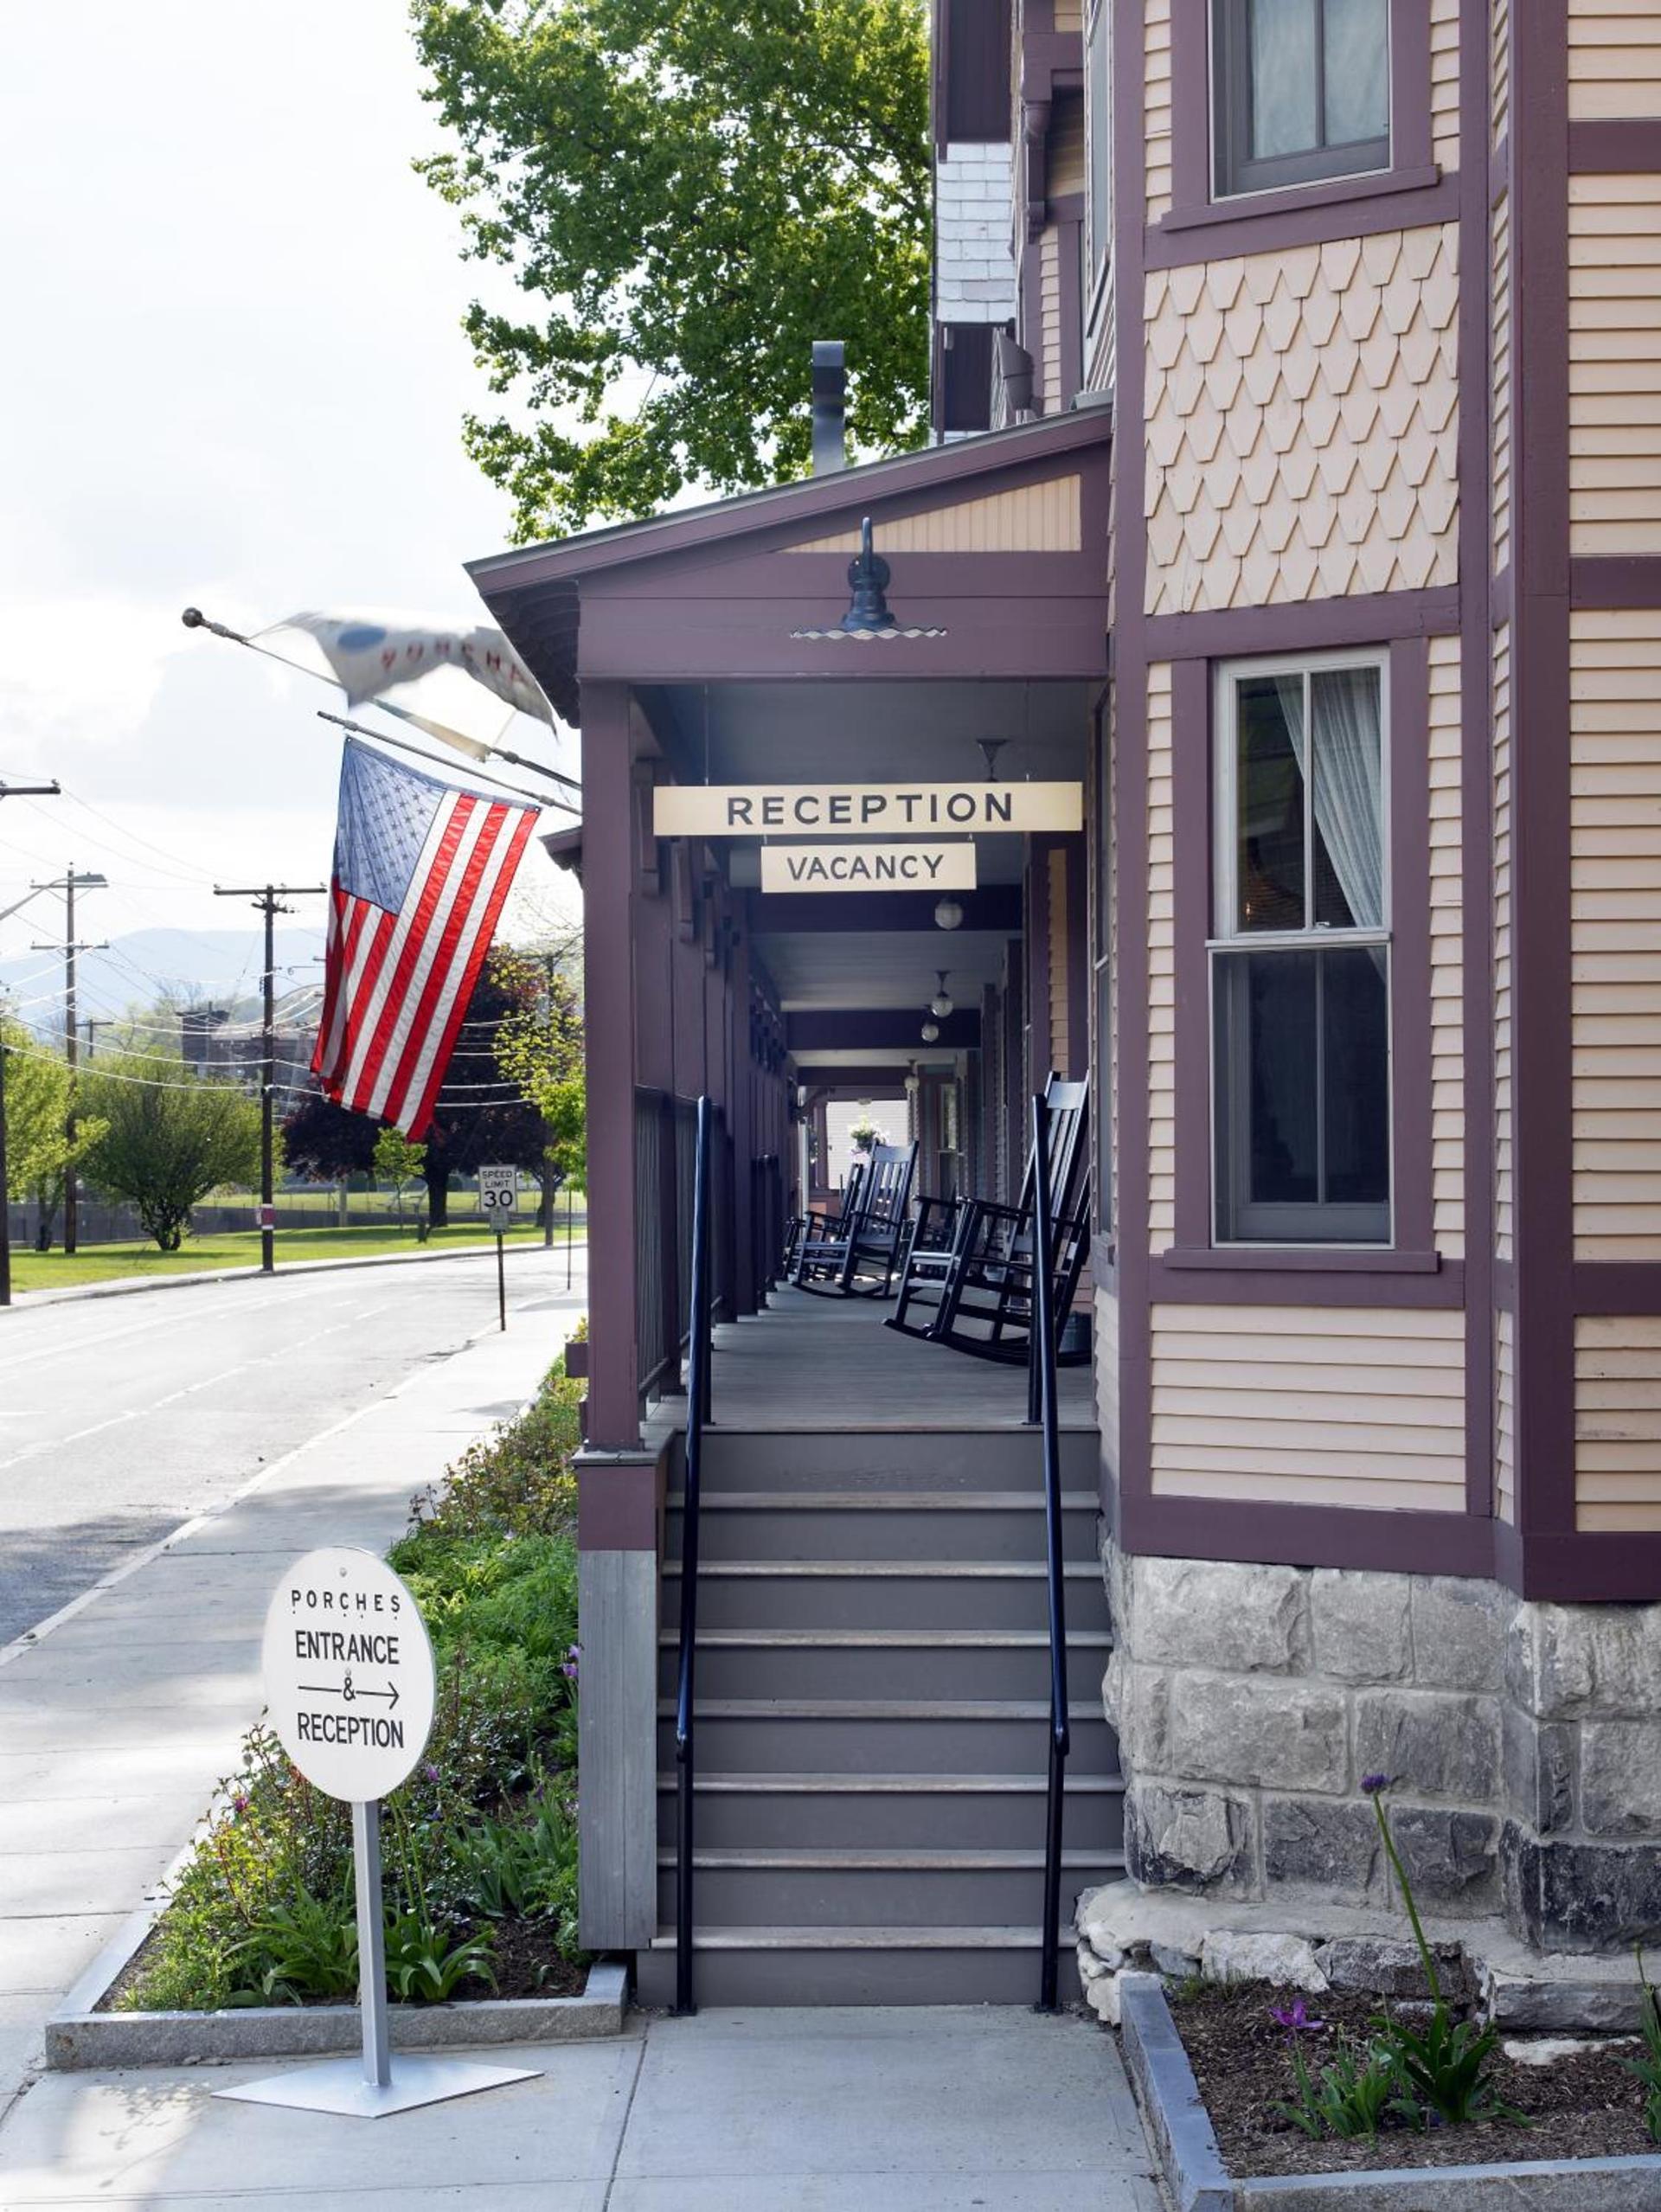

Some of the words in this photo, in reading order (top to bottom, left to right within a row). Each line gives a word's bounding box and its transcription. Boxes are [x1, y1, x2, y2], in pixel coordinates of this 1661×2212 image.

[728, 792, 1012, 826] RECEPTION
[787, 855, 945, 881] VACANCY
[484, 1190, 513, 1207] 30
[292, 1590, 401, 1613] PORCHES
[295, 1630, 400, 1664] ENTRANCE
[343, 1677, 356, 1702] &
[297, 1712, 404, 1749] RECEPTION
